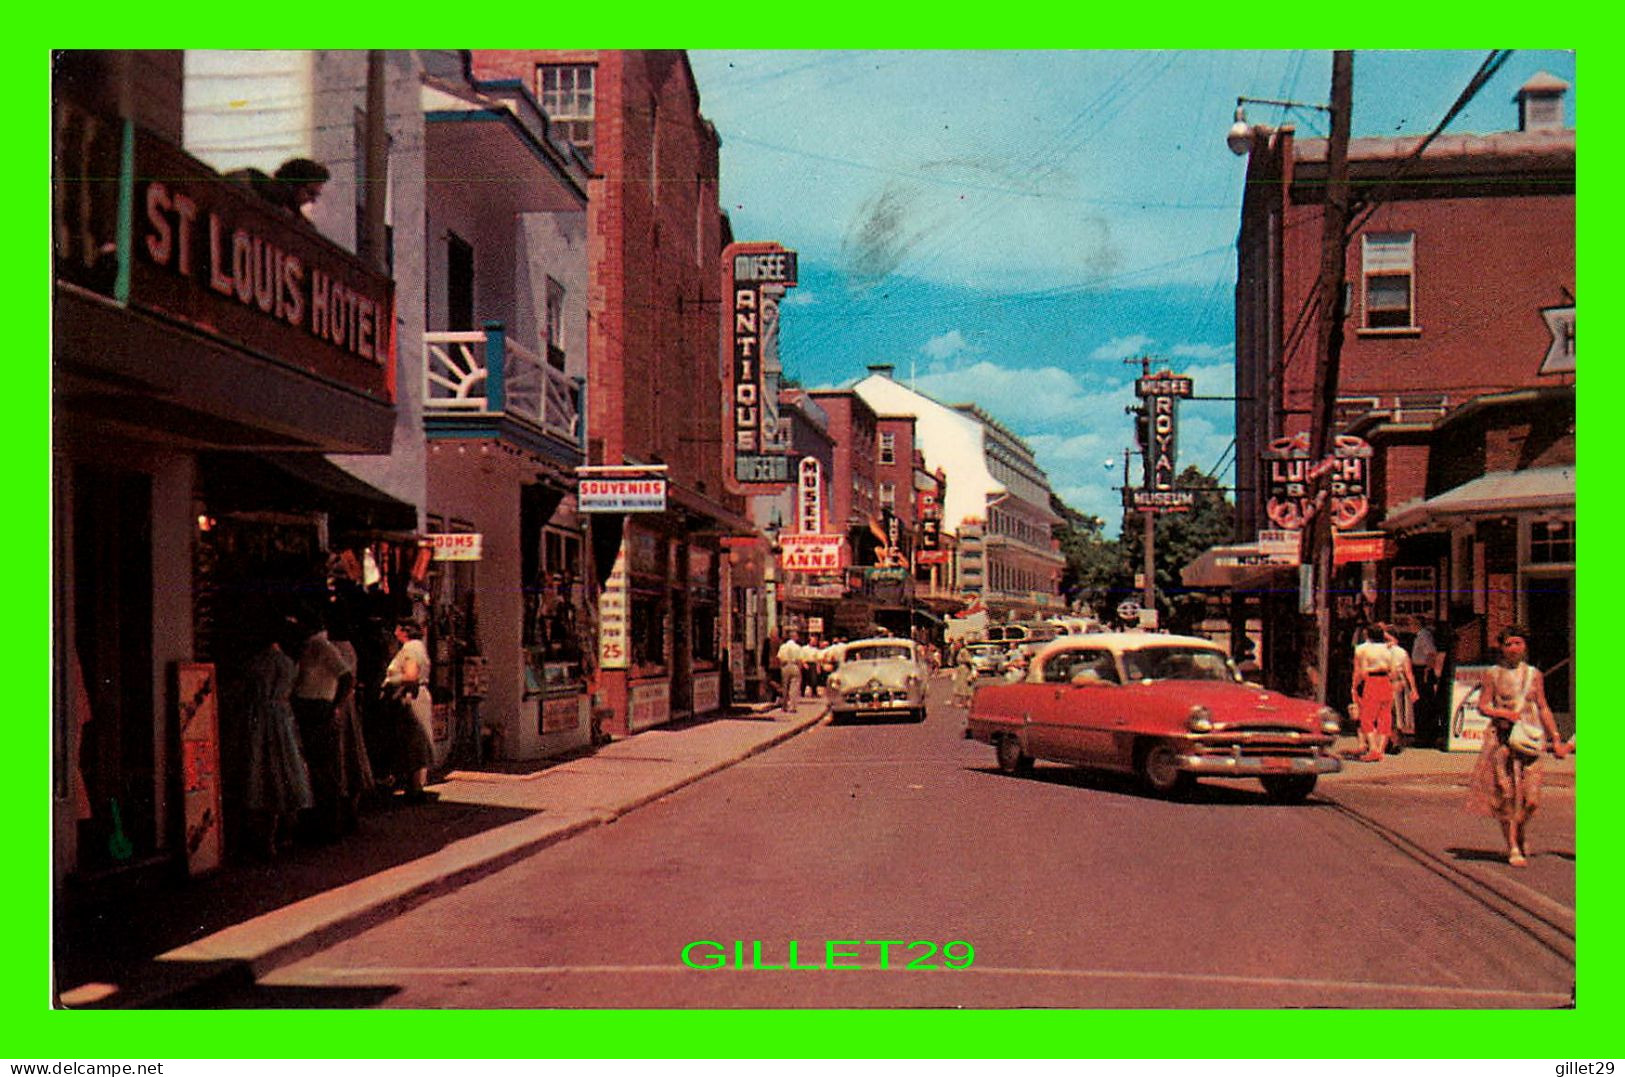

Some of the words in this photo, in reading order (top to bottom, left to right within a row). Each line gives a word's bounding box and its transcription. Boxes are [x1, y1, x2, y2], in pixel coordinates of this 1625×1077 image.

[146, 182, 197, 276] ST
[209, 213, 303, 326] LOUIS
[312, 269, 387, 367] HOTEL
[737, 289, 757, 450] ANTIQUE
[1156, 397, 1172, 490] ROYAL
[580, 481, 662, 495] SOUVENIRS
[1286, 482, 1347, 496] BR
[1134, 491, 1193, 505] MUSEUM
[427, 536, 473, 548] OOMS
[786, 554, 837, 567] ANNE
